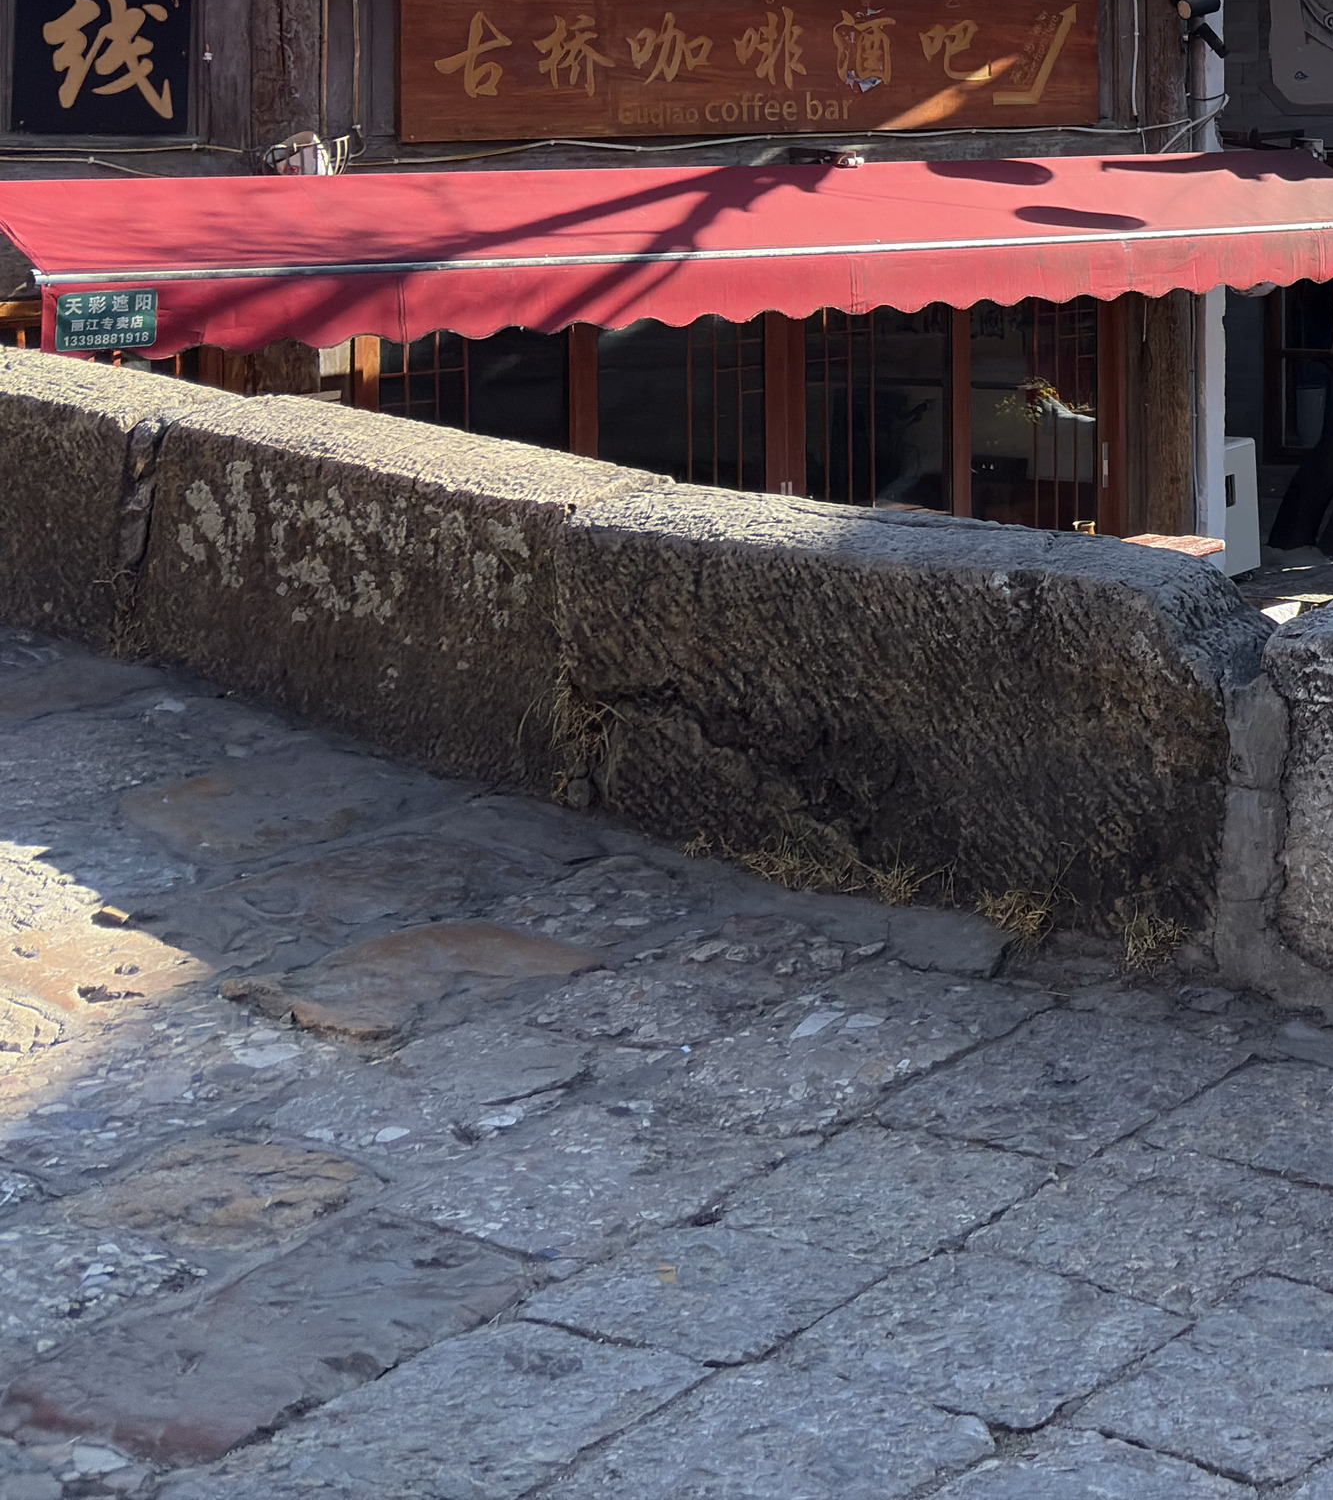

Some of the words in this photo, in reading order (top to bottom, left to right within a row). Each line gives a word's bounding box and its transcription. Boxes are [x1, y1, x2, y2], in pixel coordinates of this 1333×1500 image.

[434, 6, 992, 98] 古桥咖啡酒吧
[705, 93, 798, 123] coffee
[805, 91, 852, 121] bar
[64, 294, 152, 316] 天彩遮阳
[71, 315, 144, 332] 丽江专卖店
[63, 331, 150, 347] 13398881918
